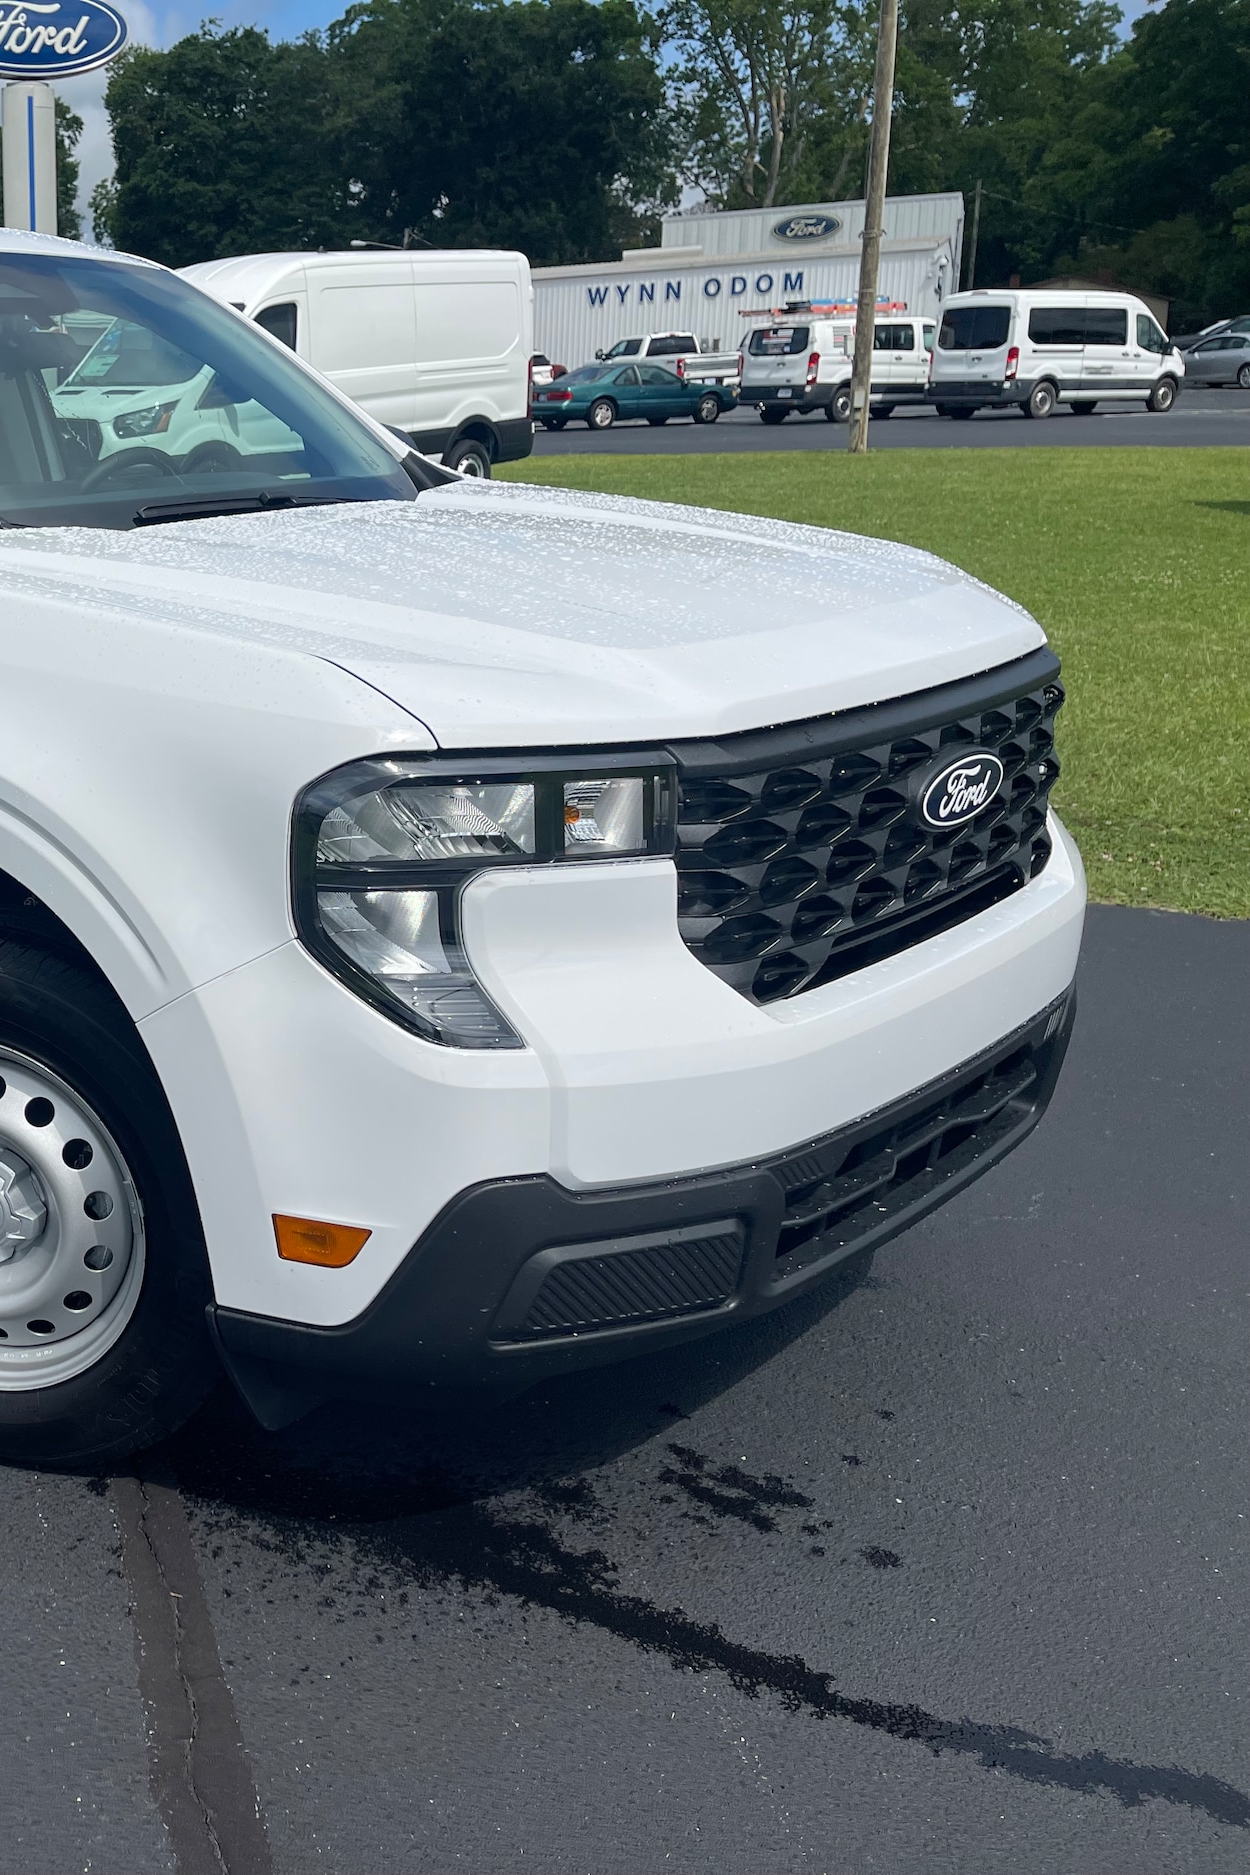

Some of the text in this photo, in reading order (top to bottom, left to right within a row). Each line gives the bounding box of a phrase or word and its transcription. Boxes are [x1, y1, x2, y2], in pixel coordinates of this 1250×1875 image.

[785, 217, 827, 239] Ford
[587, 271, 805, 306] WYNN ODOM
[938, 764, 992, 819] Ford
